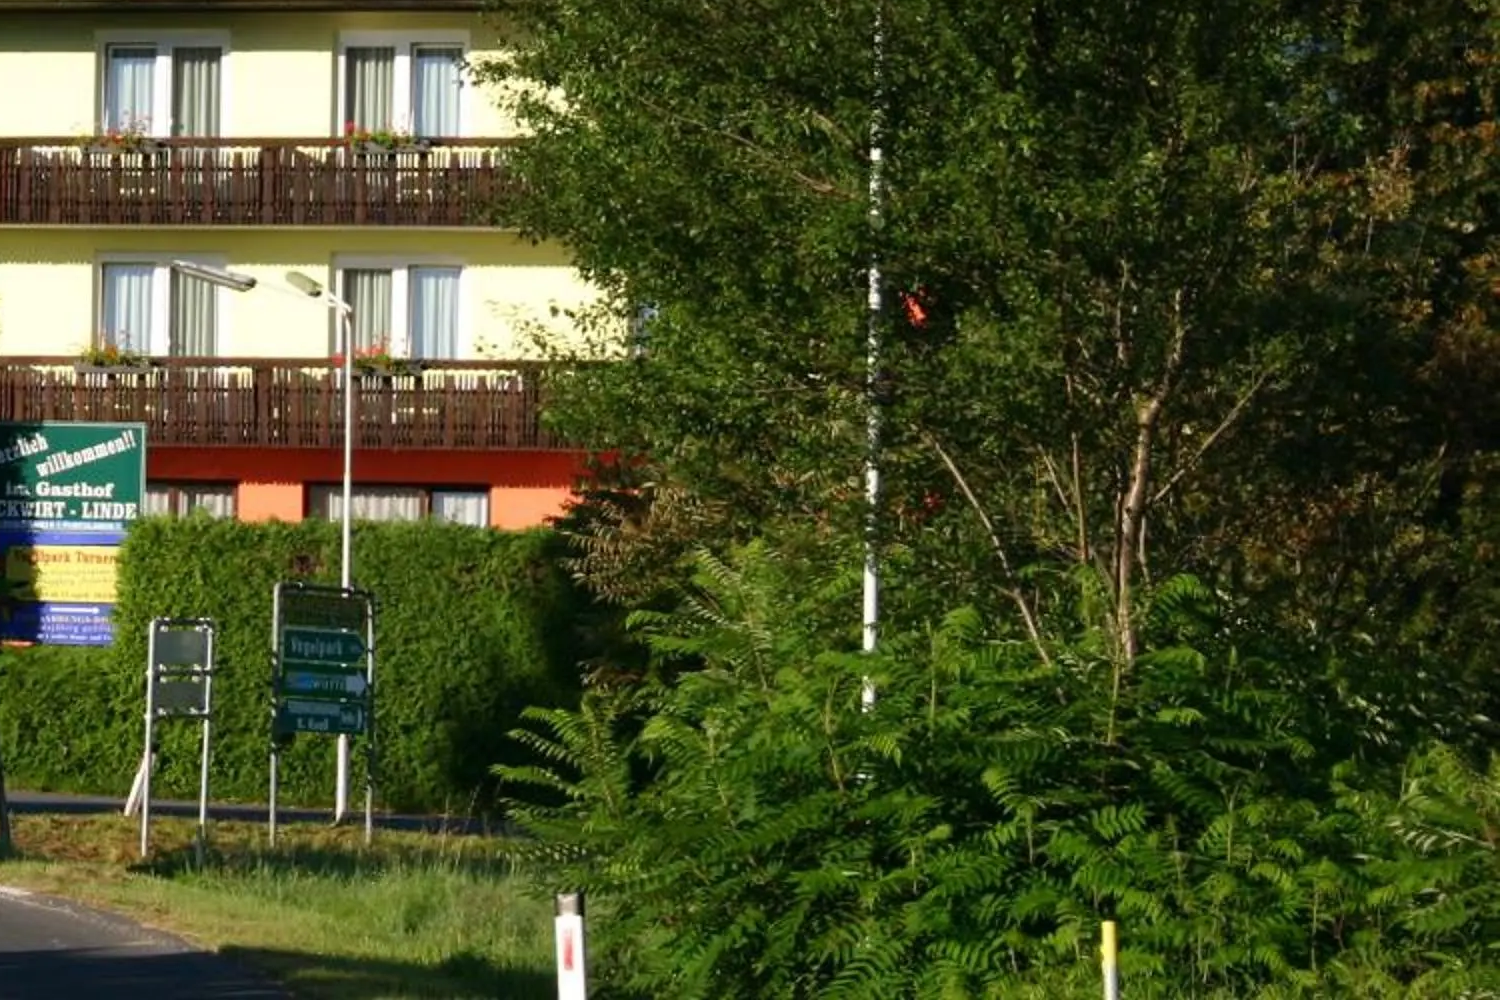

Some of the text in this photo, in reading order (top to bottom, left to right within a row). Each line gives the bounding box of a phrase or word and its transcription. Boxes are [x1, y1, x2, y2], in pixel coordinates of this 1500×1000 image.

[36, 429, 137, 477] willkommen!!
[35, 480, 116, 498] Gasthof
[81, 501, 138, 520] LINDE
